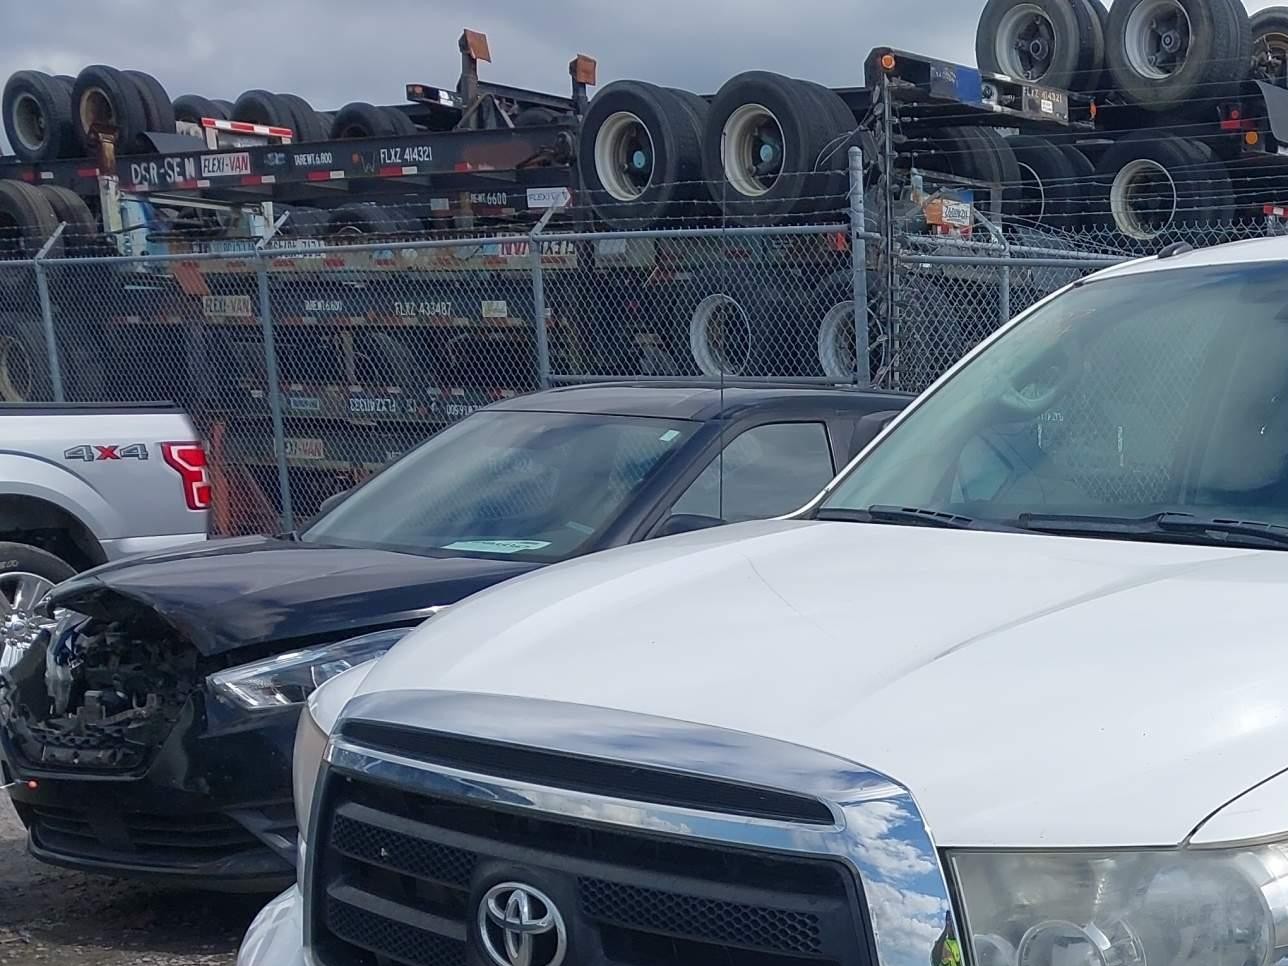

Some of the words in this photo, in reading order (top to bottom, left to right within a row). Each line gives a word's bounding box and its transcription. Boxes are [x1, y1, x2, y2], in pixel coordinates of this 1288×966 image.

[203, 154, 249, 173] FLEXI-VAN
[380, 148, 402, 163] FLXZ
[404, 146, 432, 162] 414321
